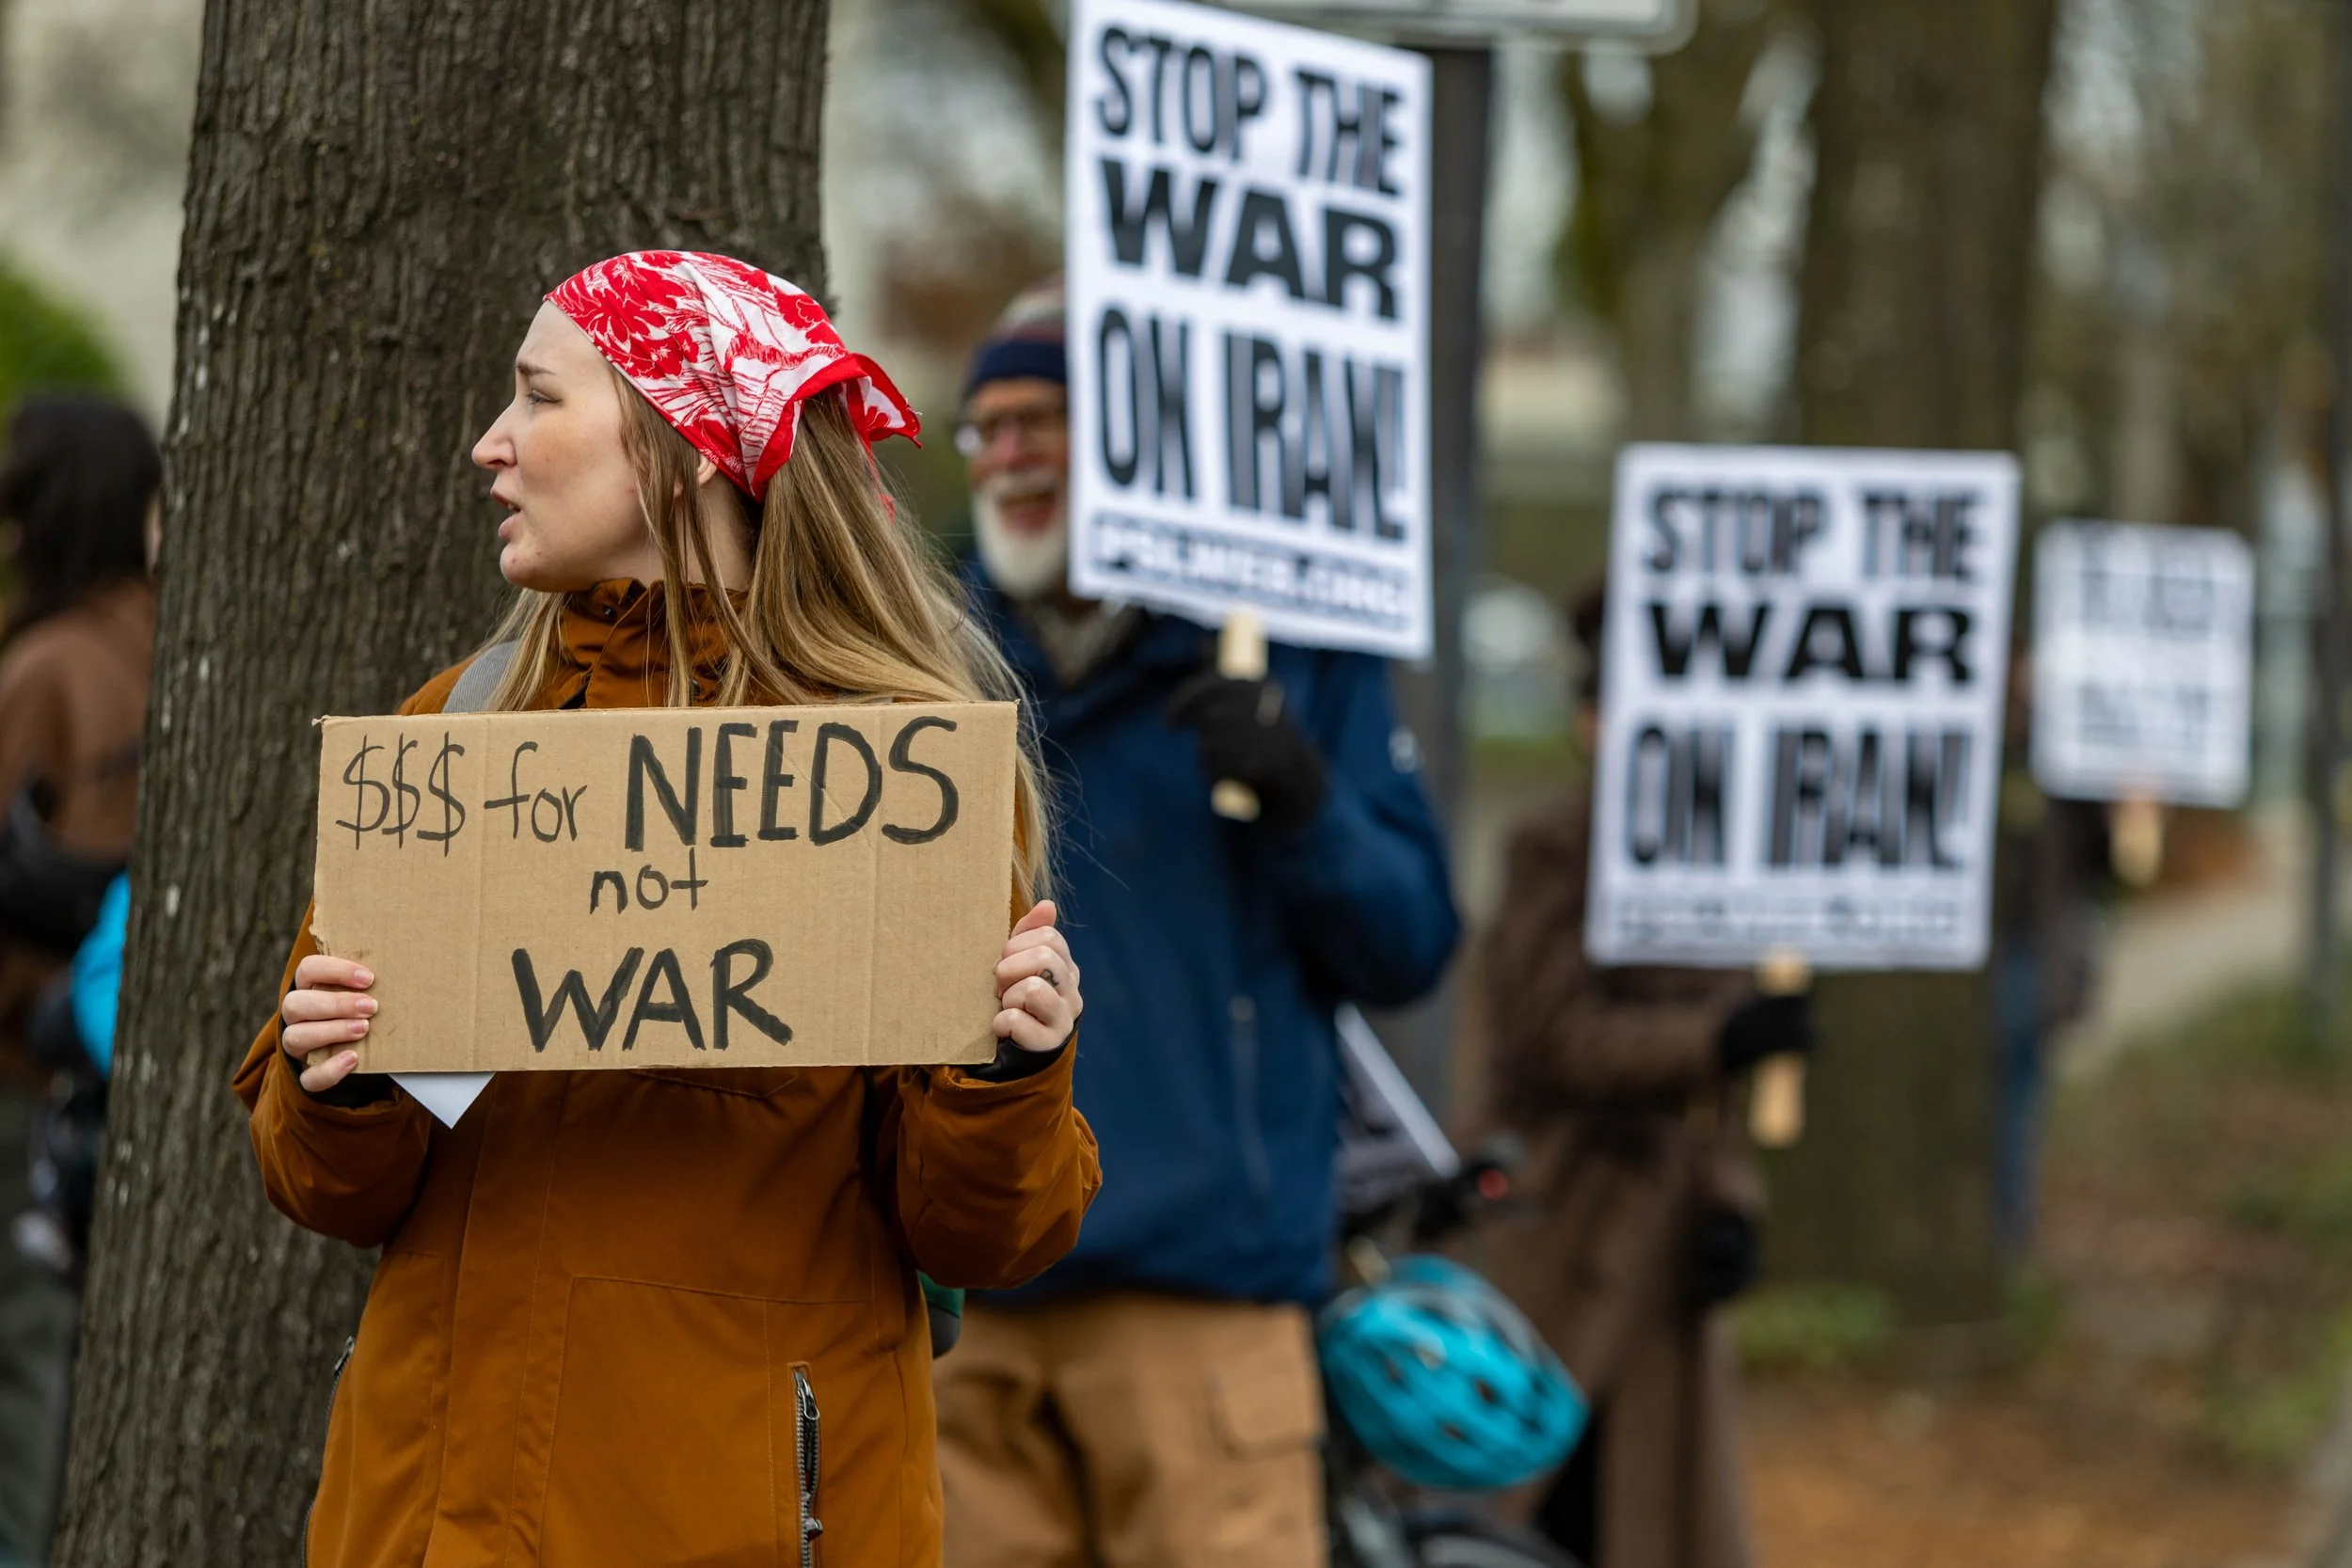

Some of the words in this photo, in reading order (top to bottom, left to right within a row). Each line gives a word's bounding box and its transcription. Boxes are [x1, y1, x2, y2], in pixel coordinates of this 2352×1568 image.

[1097, 26, 1267, 163] STOP
[1293, 68, 1403, 198] THE
[1099, 158, 1399, 322] WAR
[1096, 307, 1196, 501] ON
[1645, 487, 1827, 574] STOP
[1861, 488, 1984, 583] THE
[1647, 603, 1977, 684] WAR
[336, 731, 467, 857] $$$
[483, 741, 587, 843] for
[624, 715, 960, 852] NEEDS
[588, 847, 709, 914] not
[511, 937, 794, 1053] WAR
